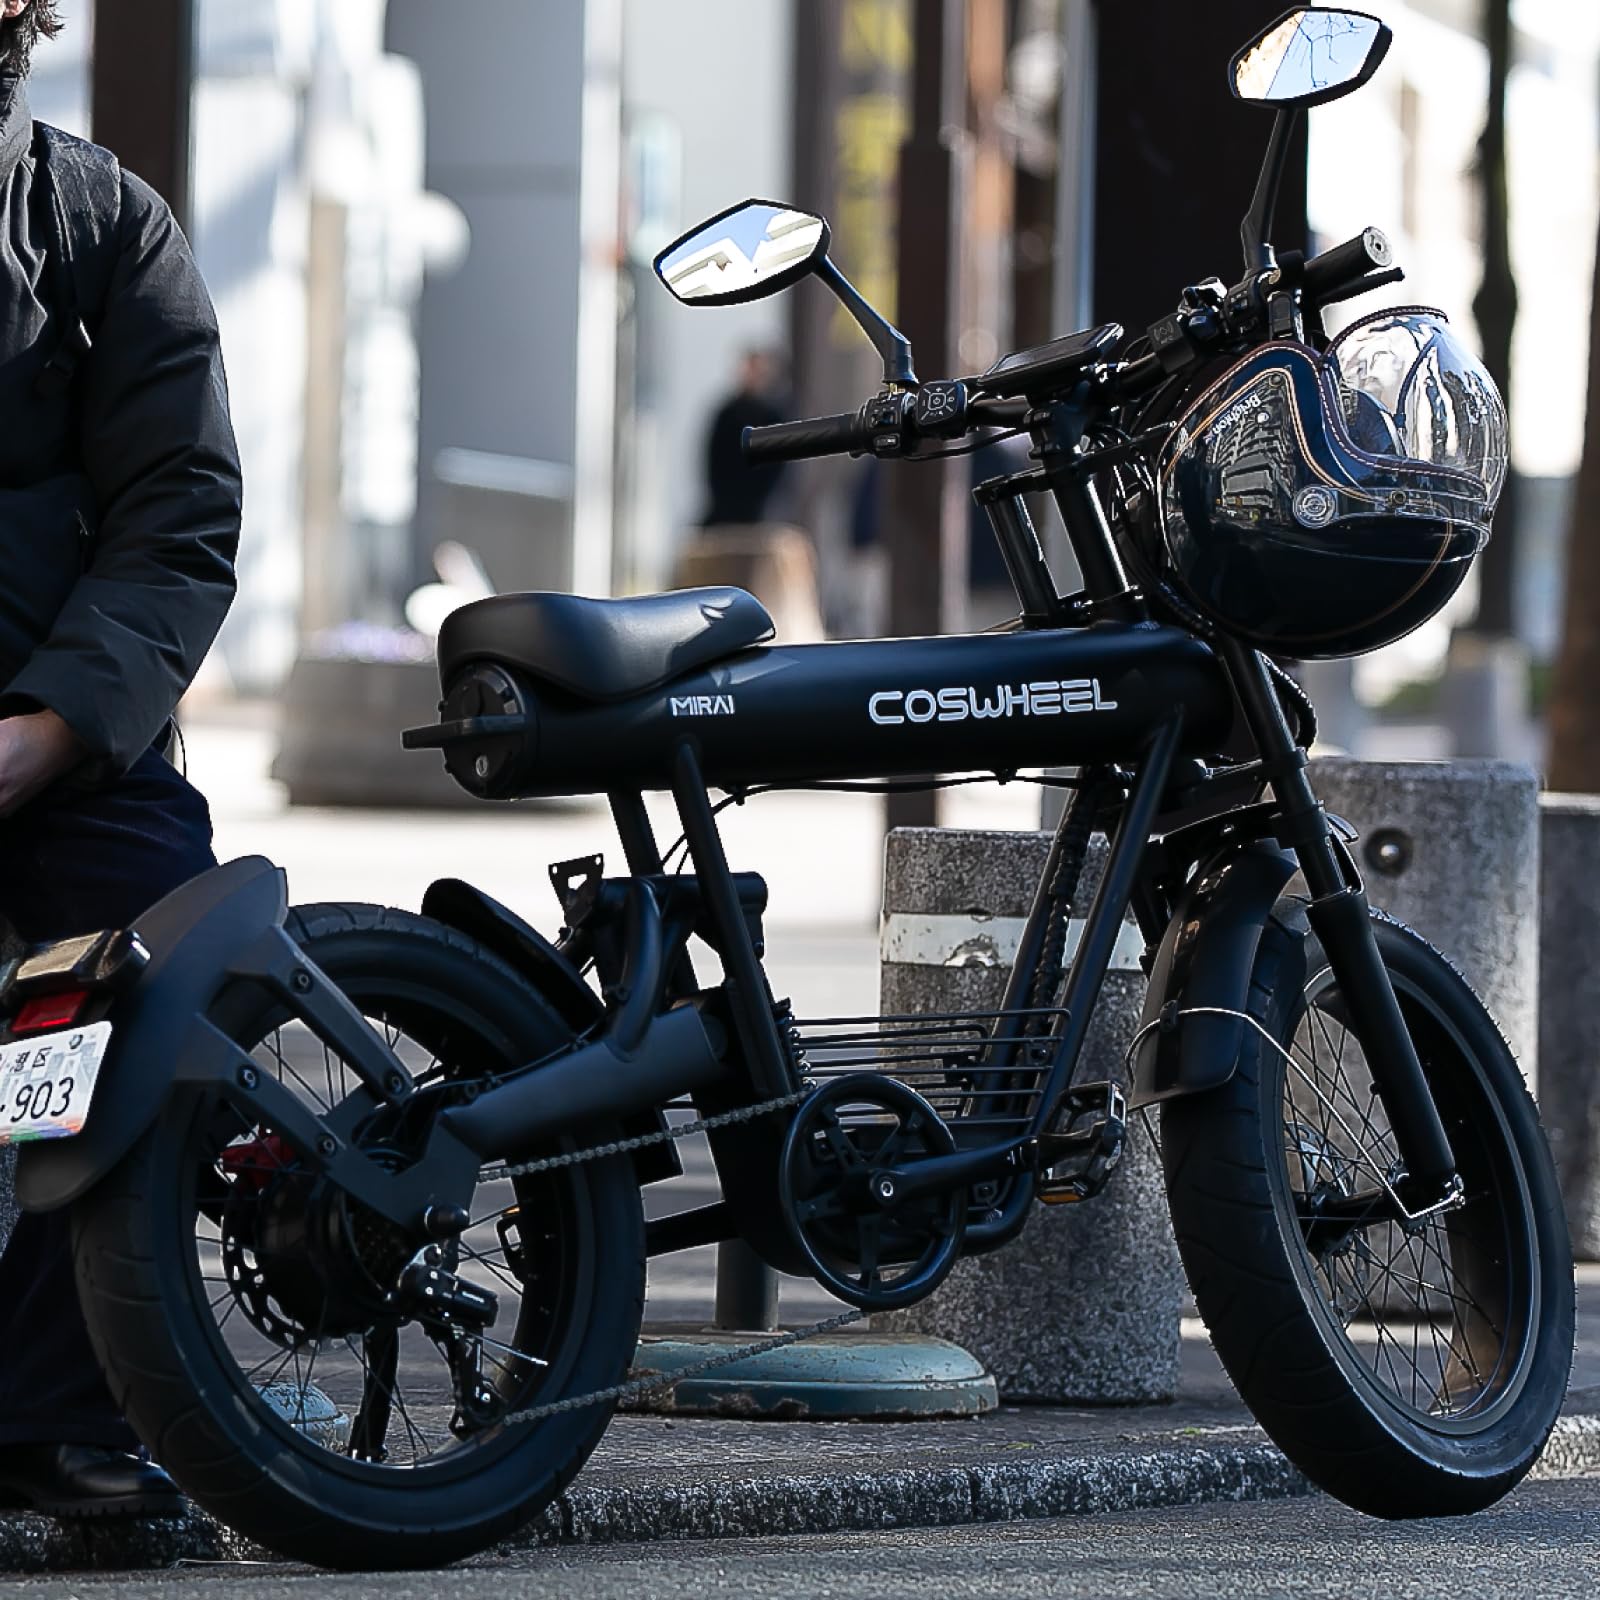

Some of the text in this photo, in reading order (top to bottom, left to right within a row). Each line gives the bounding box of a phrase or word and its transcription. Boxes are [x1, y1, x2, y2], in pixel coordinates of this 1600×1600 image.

[1212, 392, 1262, 434] Brighton
[669, 694, 735, 717] MIRAI
[868, 678, 1118, 725] COSWHEEL
